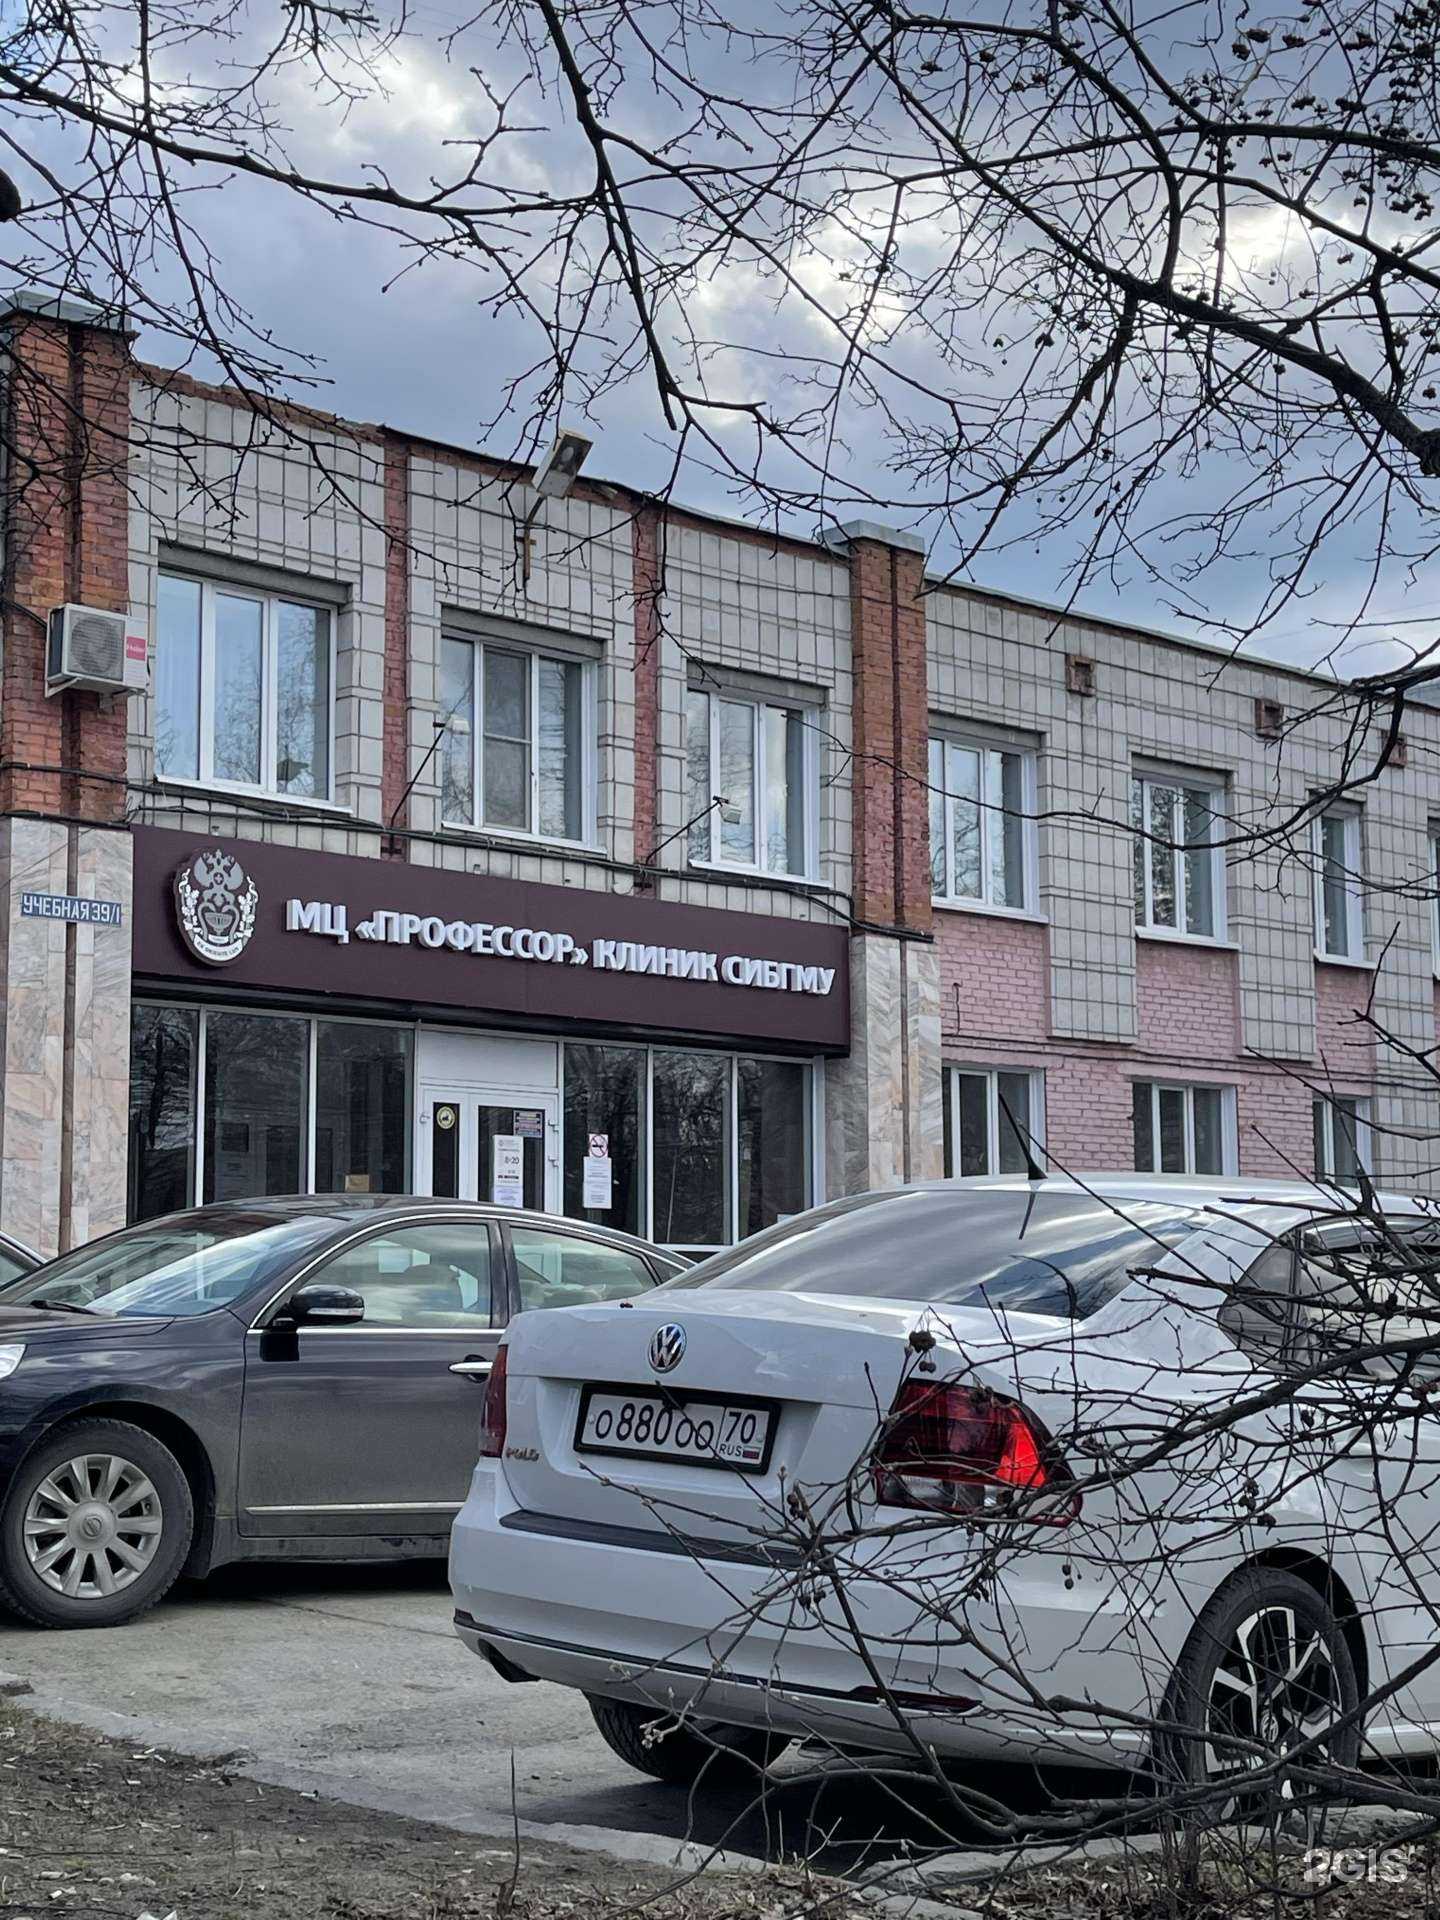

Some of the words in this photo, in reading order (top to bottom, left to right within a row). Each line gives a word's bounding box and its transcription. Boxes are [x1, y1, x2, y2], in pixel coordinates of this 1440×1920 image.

[23, 895, 90, 920] УЧЕБНАЯ
[91, 903, 120, 923] 39/1
[286, 899, 349, 944] МЦ
[355, 910, 589, 965] «ПРОФЕССОР»
[593, 939, 718, 982] КЛИНИК
[721, 956, 836, 995] СИБГМУ
[725, 1411, 757, 1444] 70
[719, 1445, 742, 1457] RUS
